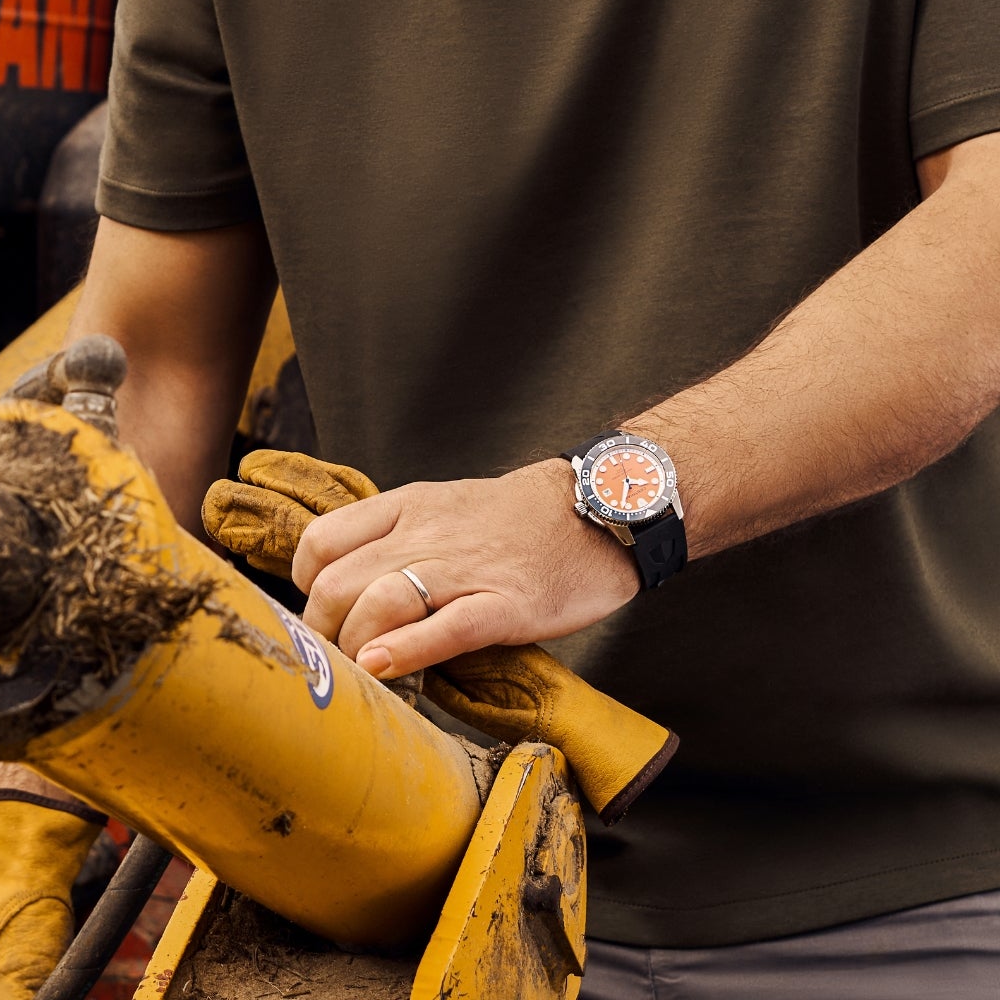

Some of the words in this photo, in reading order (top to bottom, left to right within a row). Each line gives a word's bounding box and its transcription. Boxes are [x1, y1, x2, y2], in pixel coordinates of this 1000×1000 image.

[599, 440, 616, 451] 30
[640, 441, 657, 452] 40
[582, 470, 590, 486] 20
[666, 471, 674, 487] 50
[600, 506, 613, 517] 10
